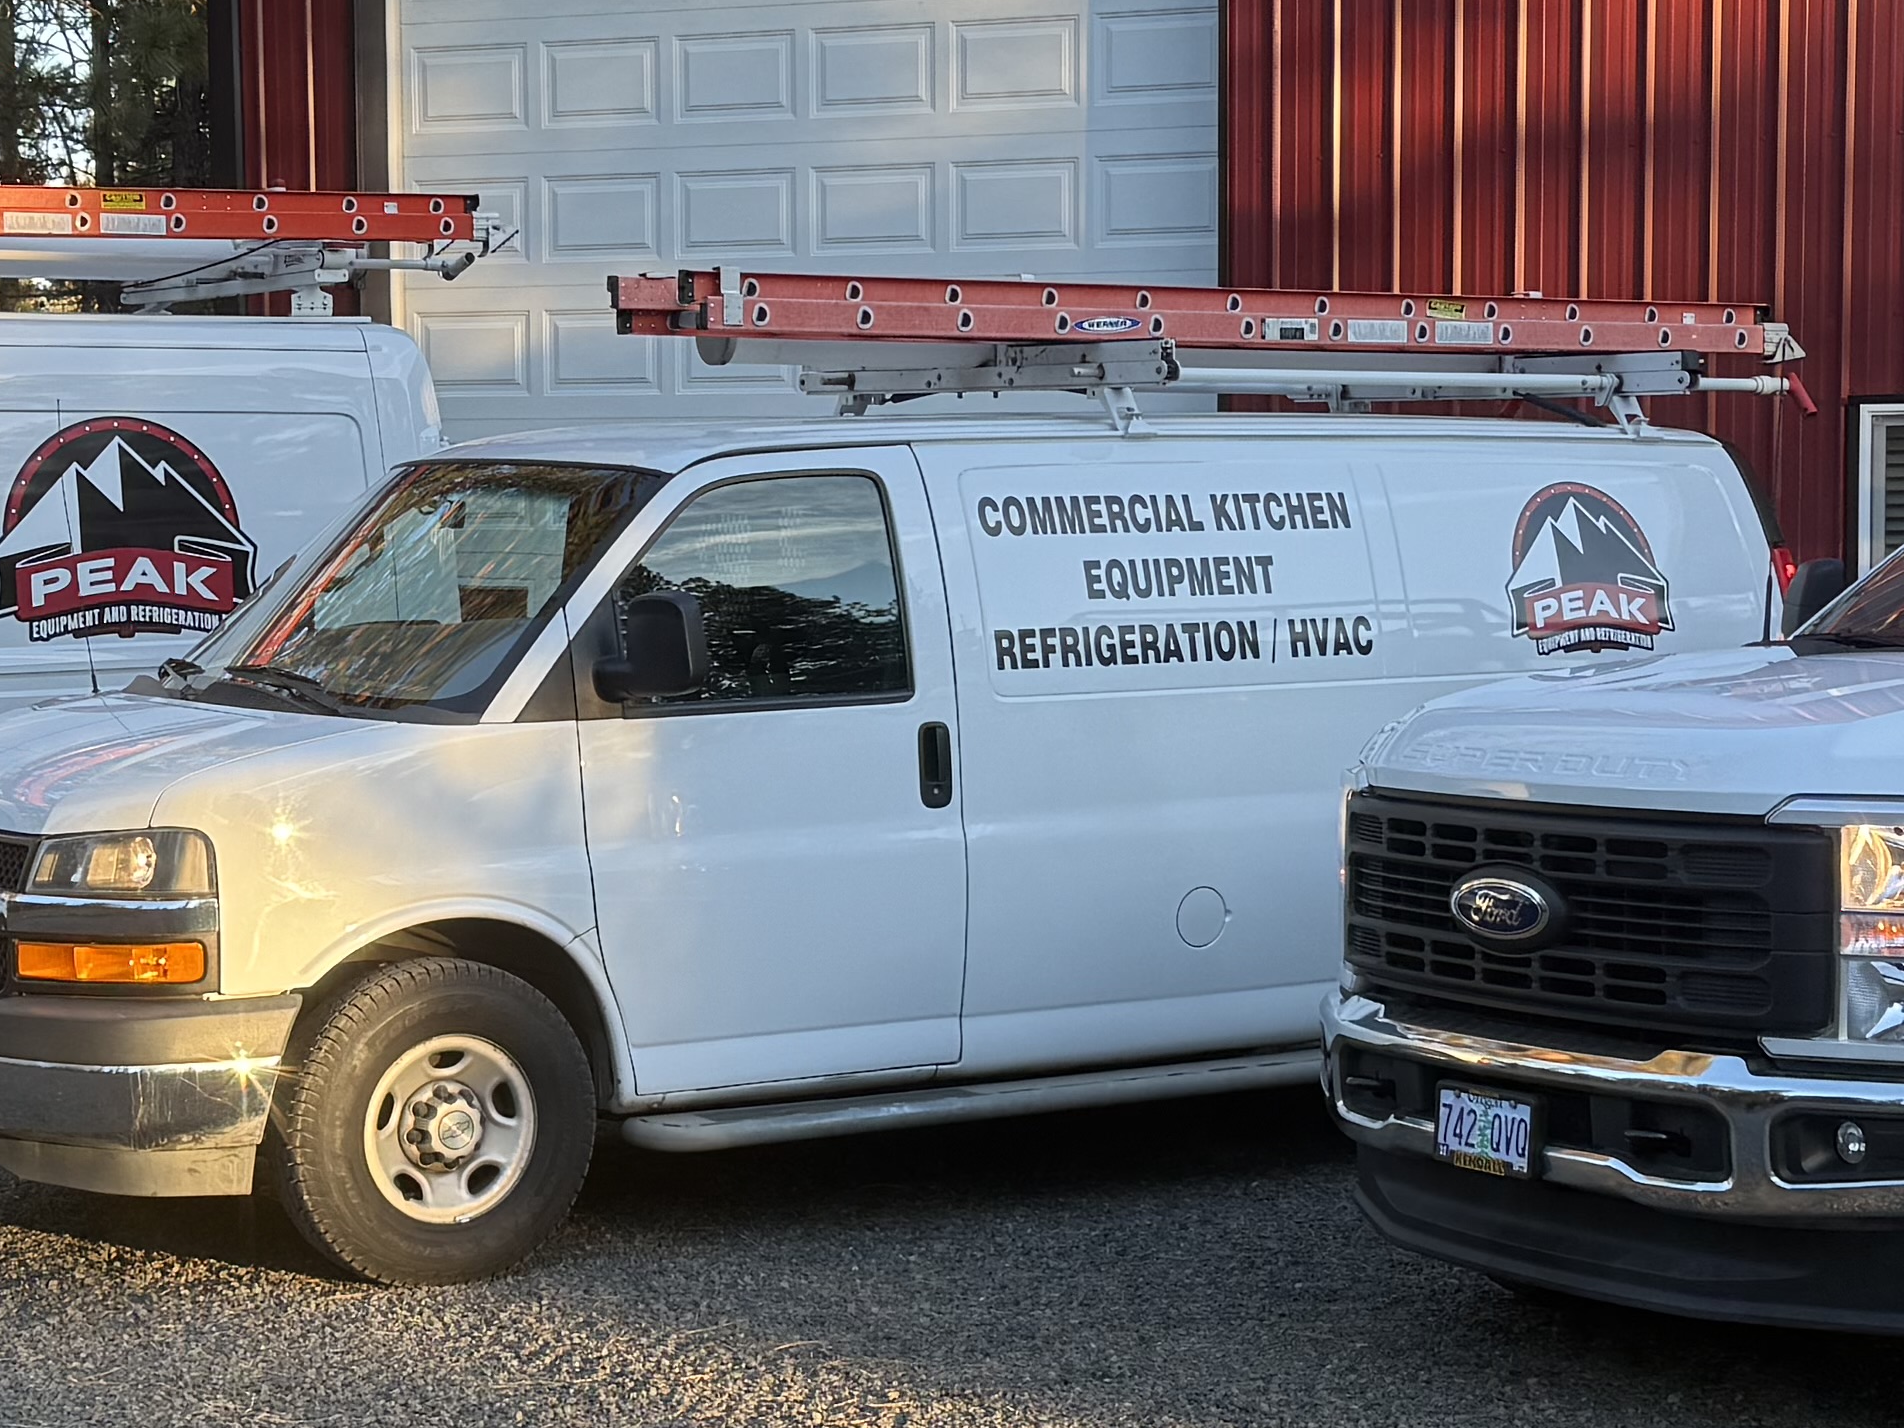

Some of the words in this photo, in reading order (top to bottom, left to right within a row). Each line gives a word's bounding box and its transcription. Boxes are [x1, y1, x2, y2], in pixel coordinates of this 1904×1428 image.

[978, 494, 1205, 537] COMMERCIAL
[1209, 491, 1352, 532] KITCHEN
[31, 556, 220, 607] PEAK
[1082, 555, 1274, 601] EQUIPMENT
[32, 608, 100, 638] EQUIPMENT
[103, 605, 127, 624] AND
[130, 605, 221, 630] REFRIGERATION
[1533, 589, 1650, 629] PEAK
[993, 620, 1261, 670] REFRIGERATION
[1288, 615, 1373, 657] HVAC
[1580, 627, 1595, 641] AND
[1442, 1103, 1478, 1148] 742
[1491, 1113, 1528, 1158] QVQ
